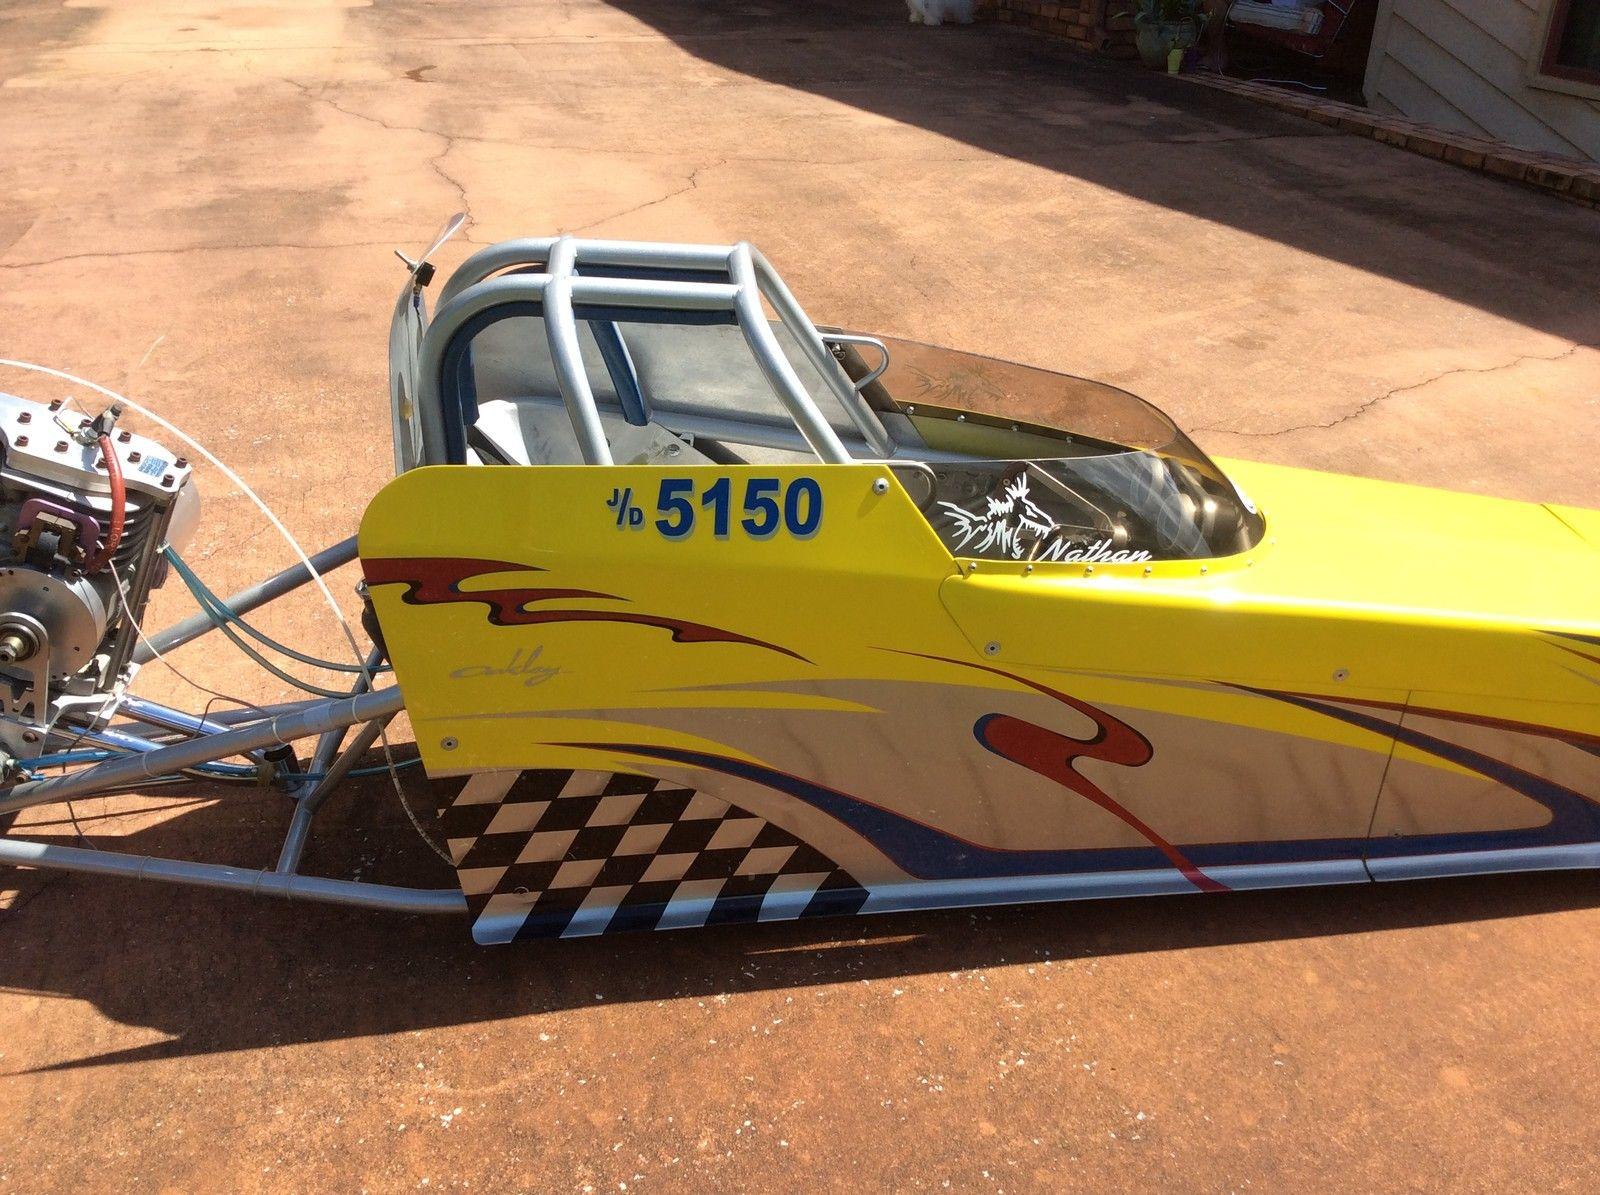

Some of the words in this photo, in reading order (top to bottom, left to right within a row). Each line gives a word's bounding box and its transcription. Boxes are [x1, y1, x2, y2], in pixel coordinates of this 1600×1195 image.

[606, 487, 644, 529] J/D
[654, 477, 823, 539] 5150
[1036, 538, 1152, 562] Nathan
